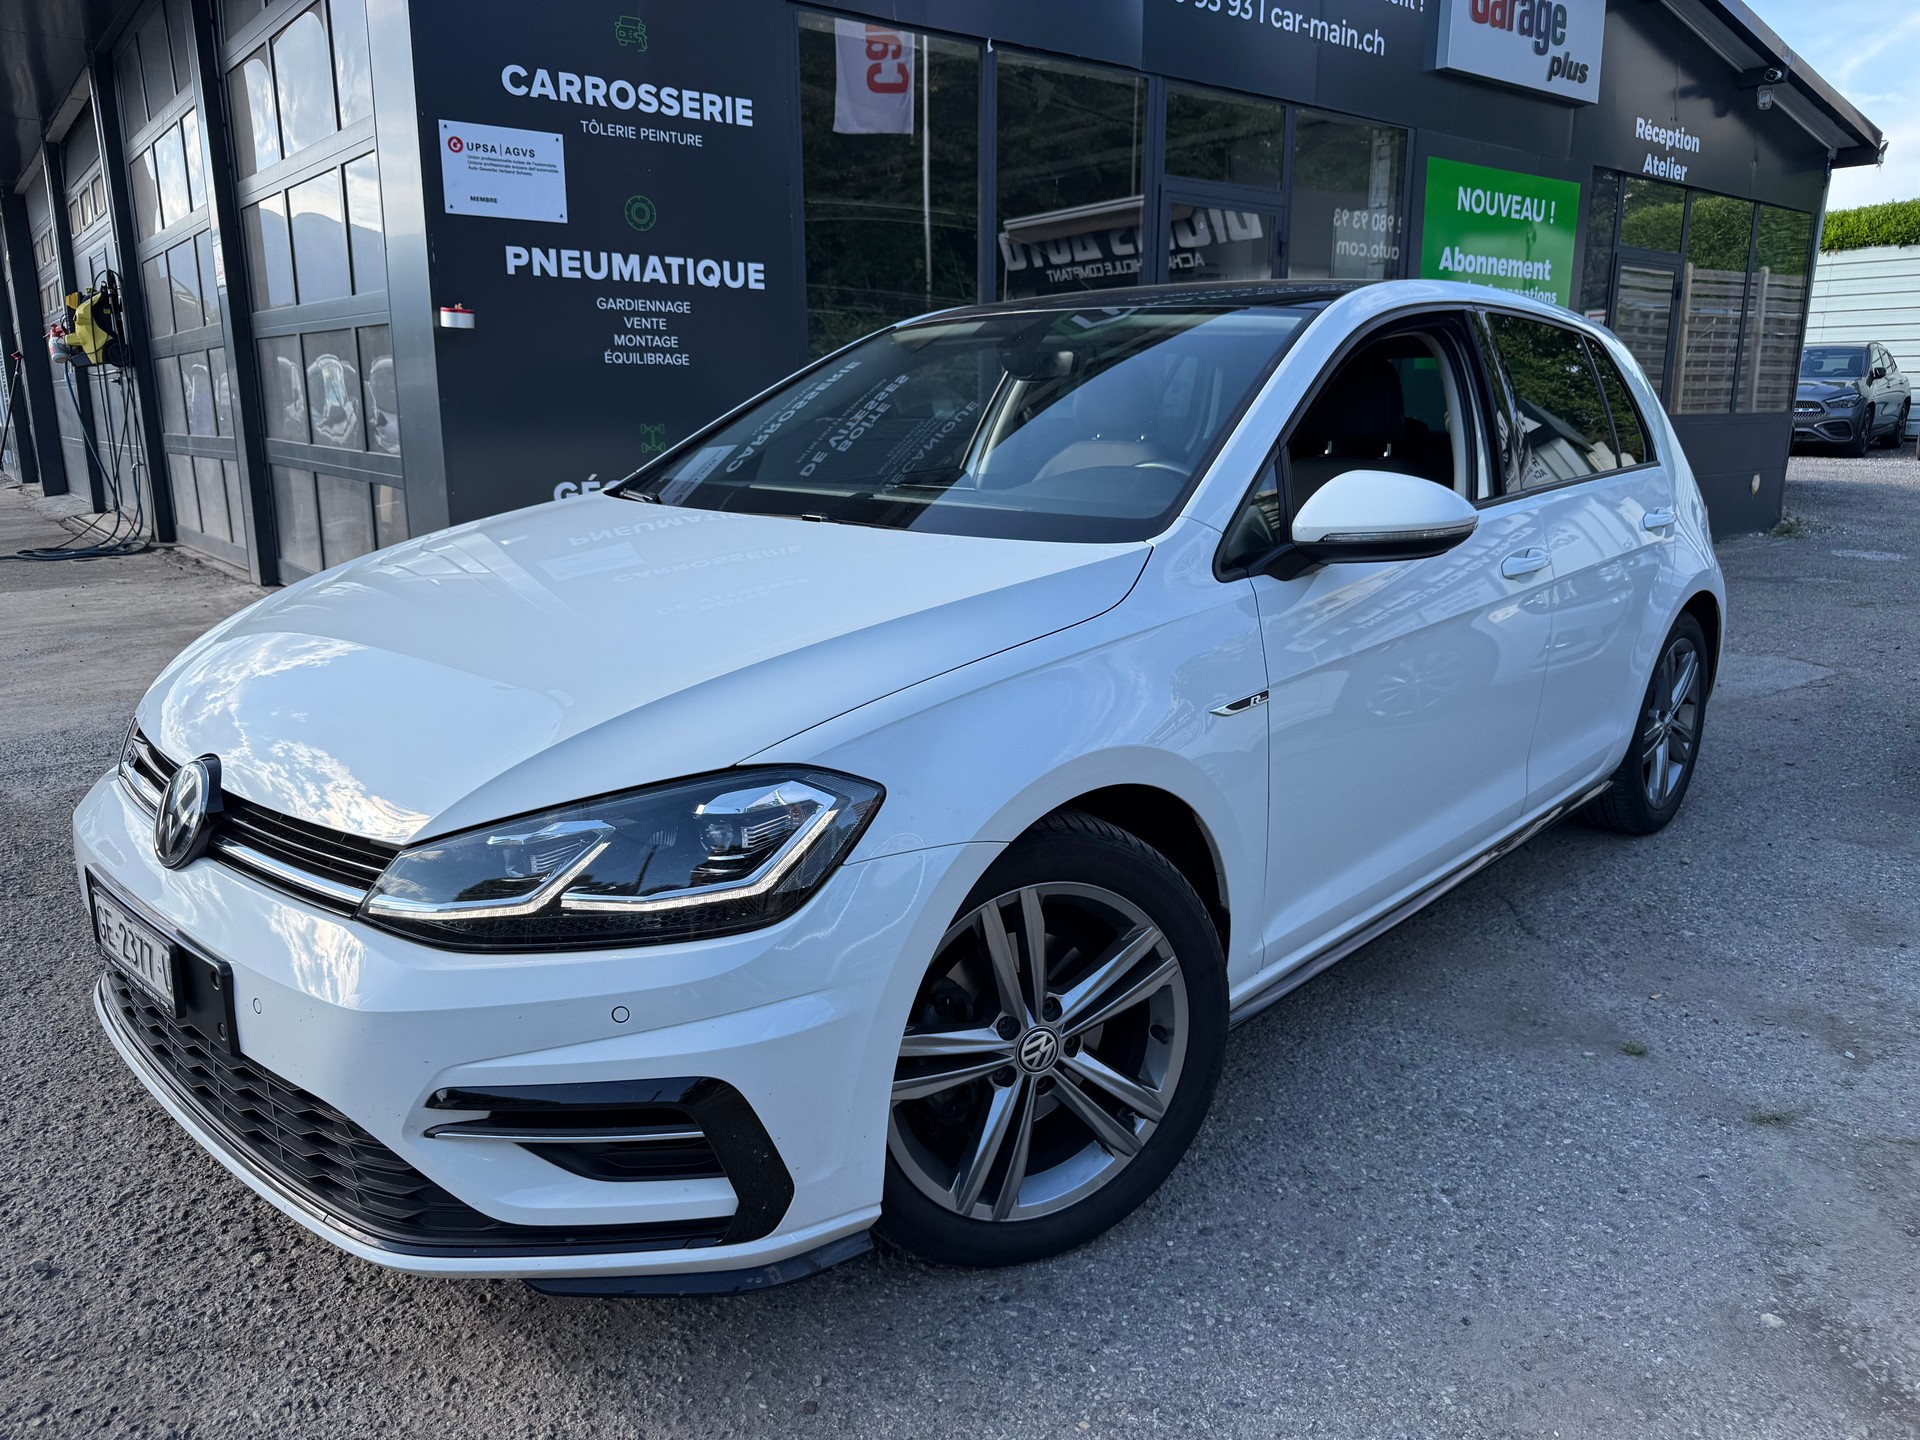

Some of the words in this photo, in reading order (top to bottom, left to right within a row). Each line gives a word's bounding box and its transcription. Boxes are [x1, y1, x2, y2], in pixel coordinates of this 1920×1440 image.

[1270, 6, 1385, 56] car-main.ch
[1546, 51, 1589, 84] plus
[501, 64, 754, 127] CARROSSERIE
[580, 118, 637, 140] TÔLERIE
[640, 127, 703, 148] PEINTURE
[1635, 116, 1700, 153] Réception
[466, 142, 497, 154] UPSA
[504, 146, 536, 158] AGVS
[1642, 153, 1688, 181] Atelier
[470, 195, 498, 204] MEMBRE
[1457, 186, 1546, 223] NOUVEAU
[1549, 200, 1556, 224] !
[505, 245, 765, 291] PNEUMATIQUE
[1438, 246, 1552, 281] Abonnement
[596, 297, 691, 315] GARDIENNAGE
[623, 316, 667, 331] VENTE
[613, 334, 679, 349] MONTAGE
[604, 349, 690, 367] ÉQUILIBRAGE
